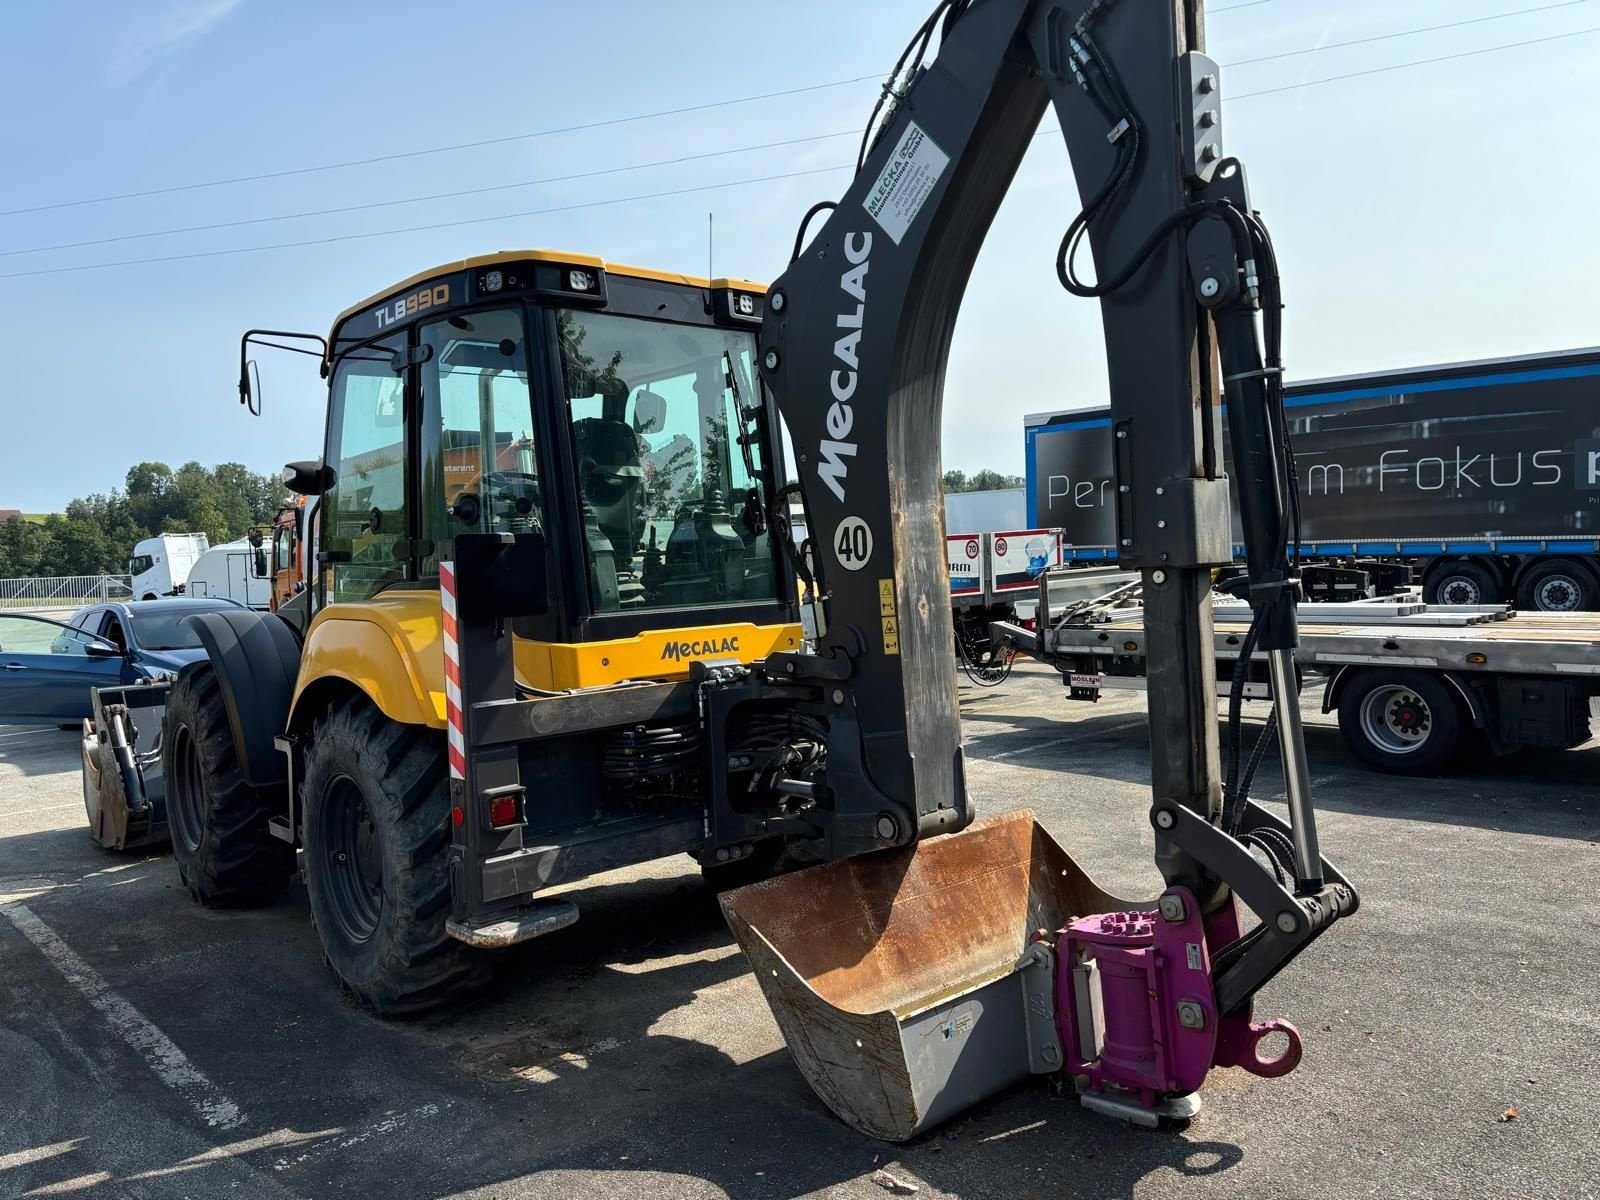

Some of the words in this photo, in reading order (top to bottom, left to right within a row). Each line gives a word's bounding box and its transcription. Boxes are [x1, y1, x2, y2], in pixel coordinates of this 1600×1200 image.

[873, 161, 909, 218] Baumaschinen
[908, 133, 925, 159] GmbH
[375, 284, 449, 329] TLB990
[838, 525, 868, 562] 40
[968, 545, 977, 553] 70
